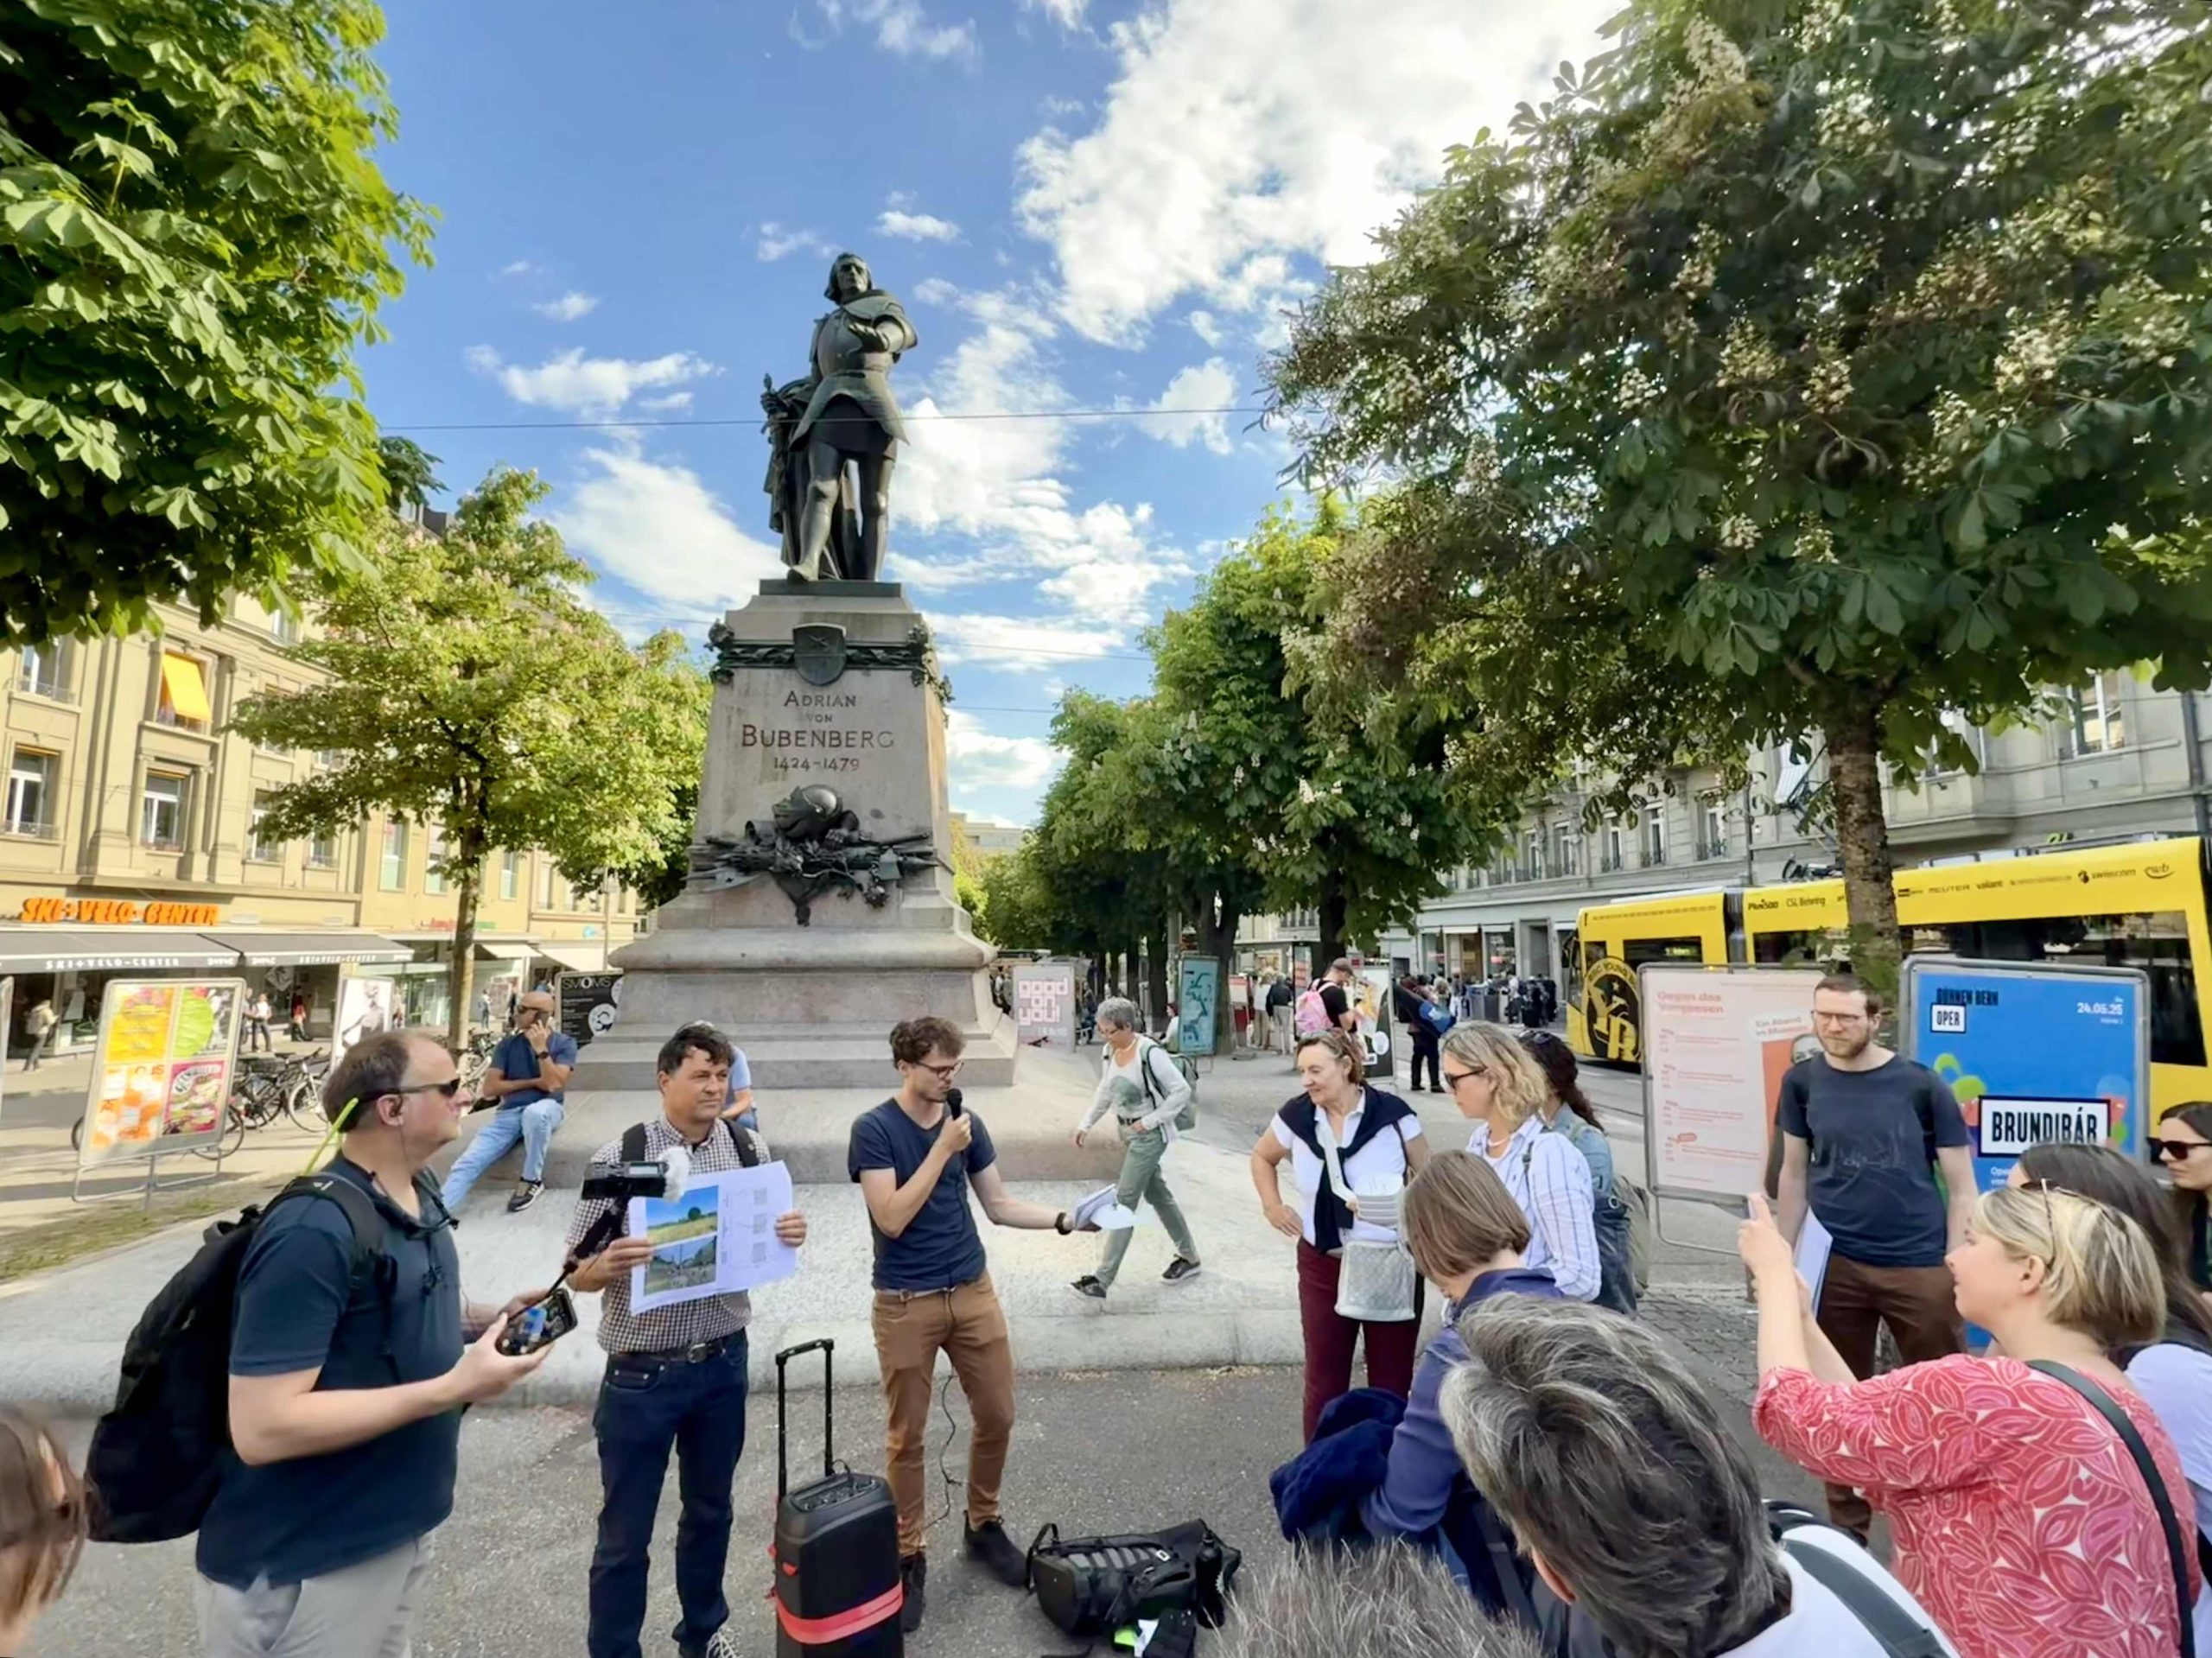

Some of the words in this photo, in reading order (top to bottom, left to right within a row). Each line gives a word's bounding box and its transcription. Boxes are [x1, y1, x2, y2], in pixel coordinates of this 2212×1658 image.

[784, 690, 856, 707] ADRIAN
[741, 724, 894, 748] BUBENBERG
[774, 757, 860, 771] 1424-1479
[1936, 1010, 1960, 1026] OPER
[1991, 1106, 2098, 1144] BRUNDIBÁR
